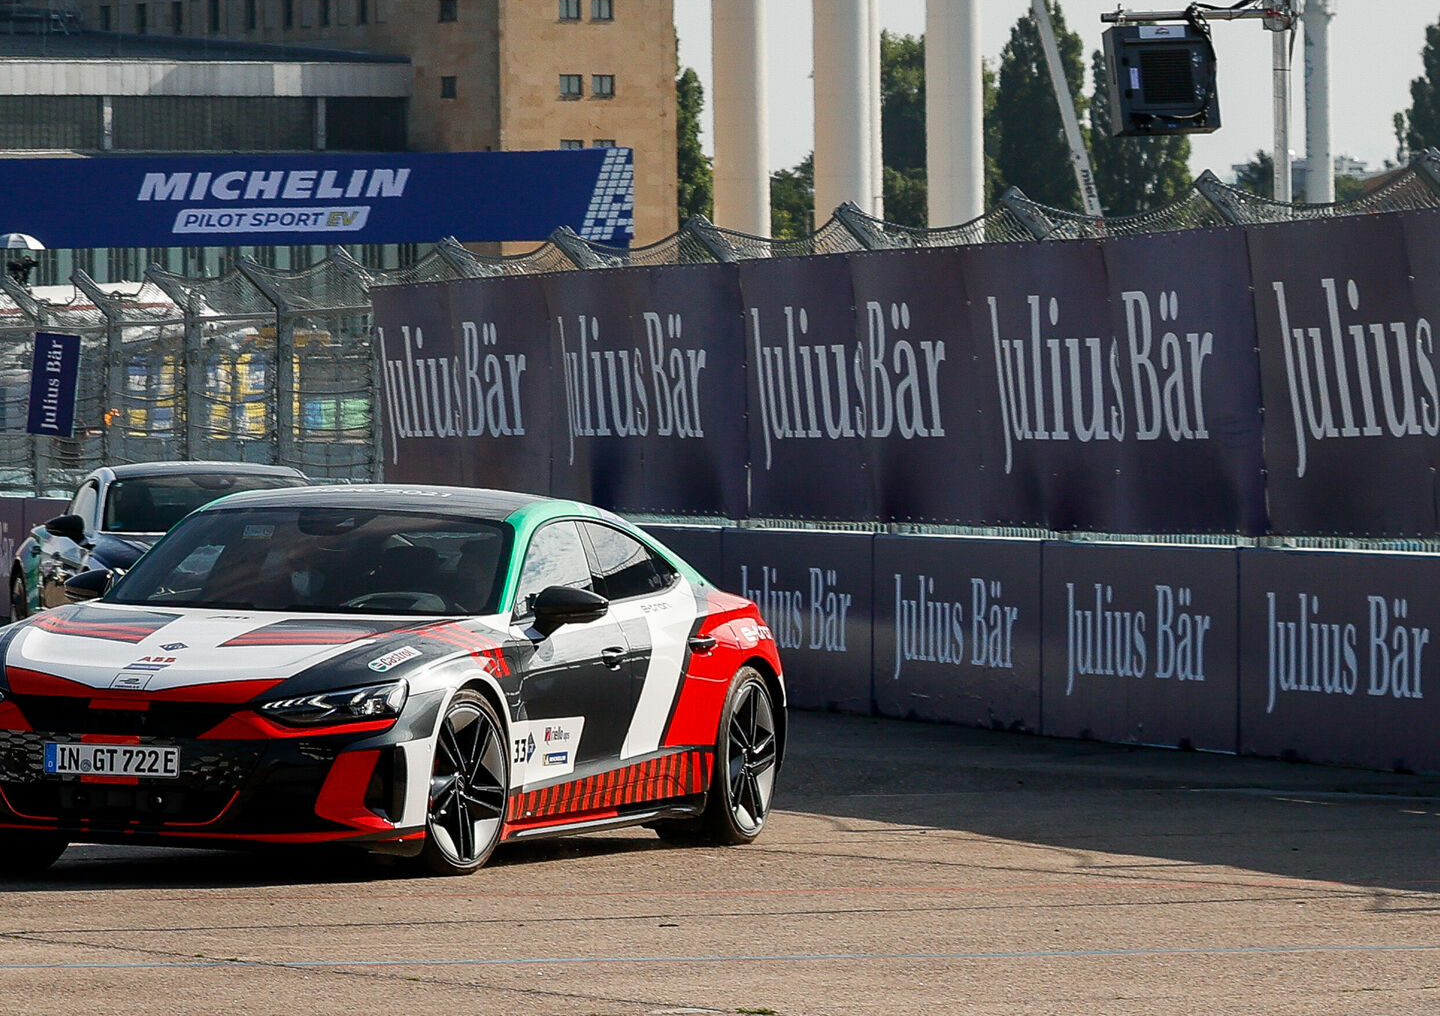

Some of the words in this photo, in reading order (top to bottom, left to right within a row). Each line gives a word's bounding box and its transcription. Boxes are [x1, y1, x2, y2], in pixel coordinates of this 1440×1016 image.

[137, 168, 411, 201] MICHELIN
[184, 213, 249, 228] PILOT
[249, 212, 324, 227] SPORT
[326, 211, 359, 226] EV
[46, 339, 63, 373] Bär
[378, 325, 462, 466] Julius
[461, 321, 527, 438] Bär
[557, 314, 649, 466] Julius
[643, 311, 706, 439] Bär
[750, 306, 865, 471] Julius
[866, 300, 945, 440] Bär
[987, 294, 1126, 474] Julius
[1122, 290, 1213, 443] Bär
[1271, 275, 1440, 478] Julius
[40, 378, 60, 431] Julius
[740, 566, 802, 650] lius
[809, 567, 851, 652] Bär
[894, 573, 964, 680] Julius
[971, 577, 1018, 669] Bär
[1066, 582, 1147, 696] Julius
[1155, 584, 1210, 681] Bär
[1267, 591, 1357, 713] Julius
[1367, 595, 1429, 699] Bär
[380, 648, 416, 667] Castrol
[58, 747, 80, 771] IN
[93, 748, 118, 772] GT
[513, 739, 527, 763] 33
